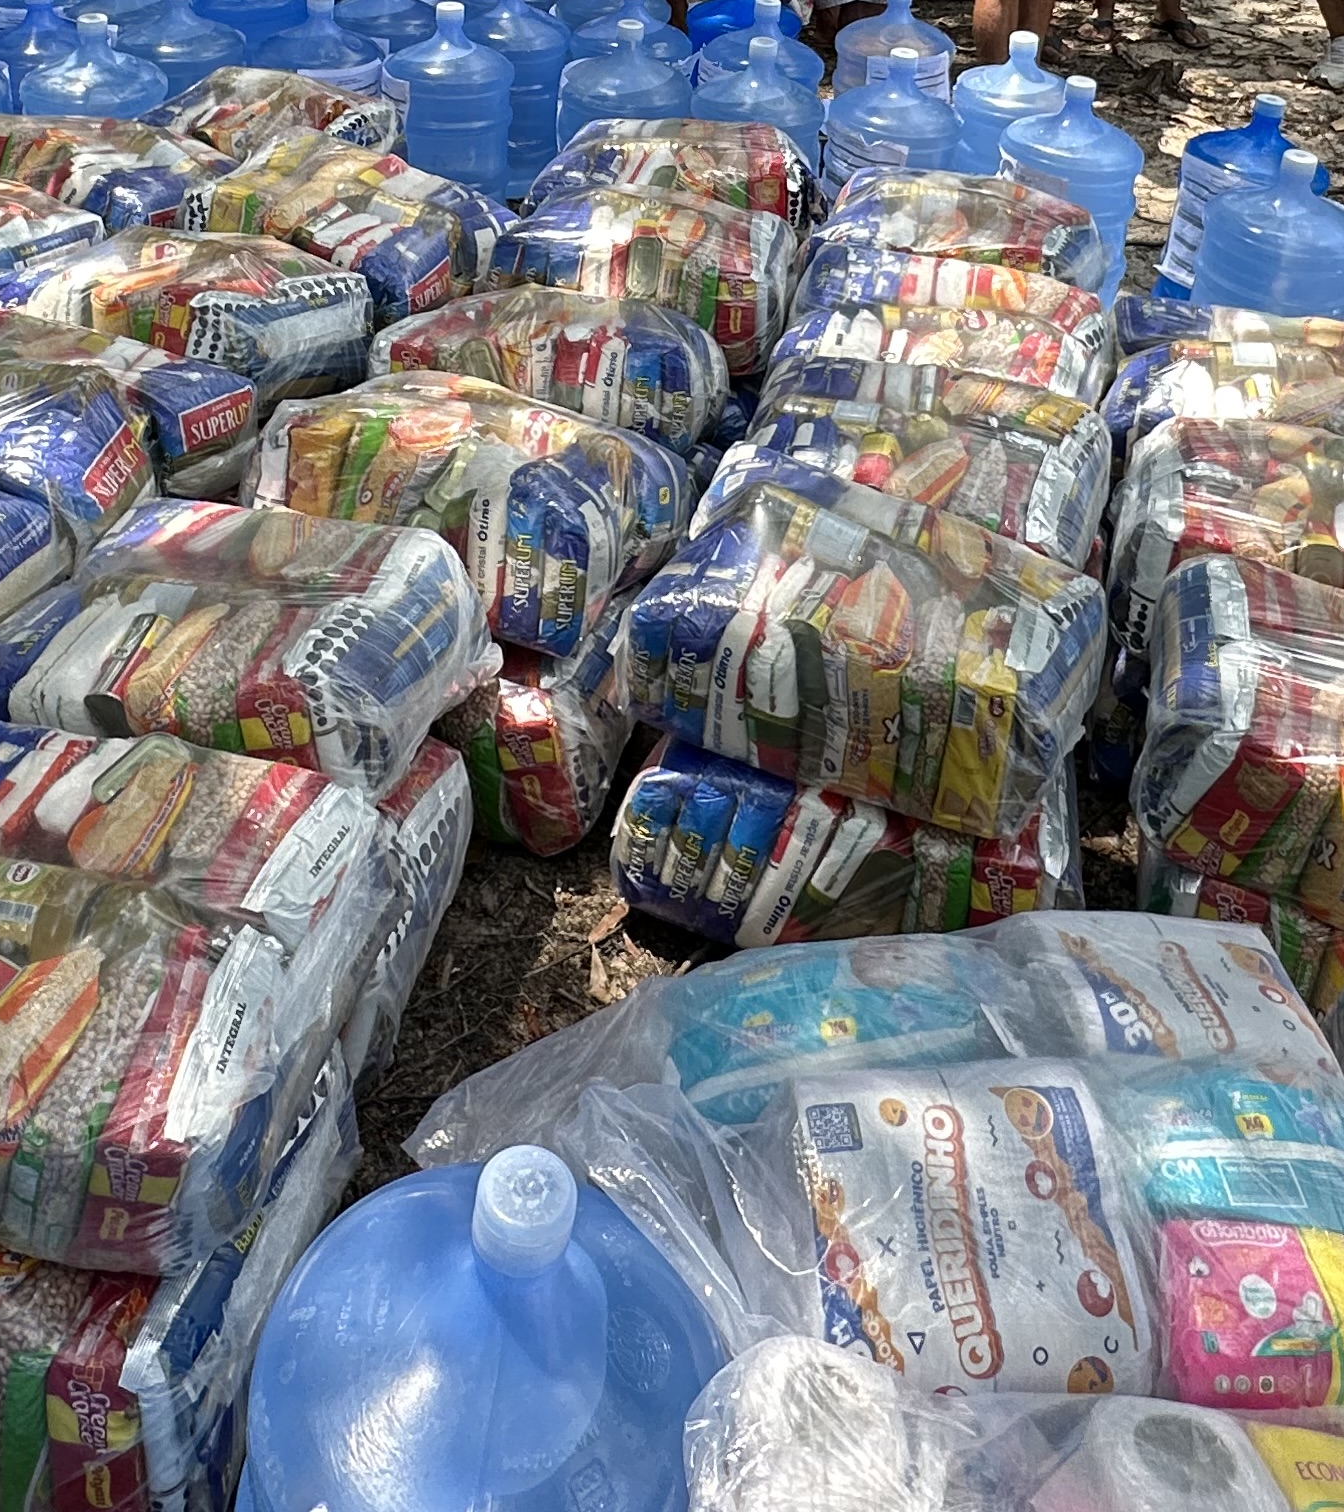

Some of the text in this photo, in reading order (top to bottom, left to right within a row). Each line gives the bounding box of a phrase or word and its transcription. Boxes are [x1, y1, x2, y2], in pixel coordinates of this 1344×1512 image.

[603, 351, 618, 387] Ótimo
[478, 498, 490, 579] Ótimo cristal
[513, 533, 533, 609] SUPERUM
[556, 559, 578, 631] SUPERUM
[673, 647, 697, 712] SUPERUM
[309, 824, 350, 879] INTEGRAL
[669, 831, 705, 903] SUPERUM
[718, 846, 758, 919] SUPERUM
[788, 860, 804, 893] cristal
[763, 895, 792, 935] Ótimo
[216, 1001, 247, 1075] INTEGRAL
[912, 1159, 946, 1313] PAPEL HIGIÊNICO
[923, 1104, 1005, 1379] QUERIDINHO
